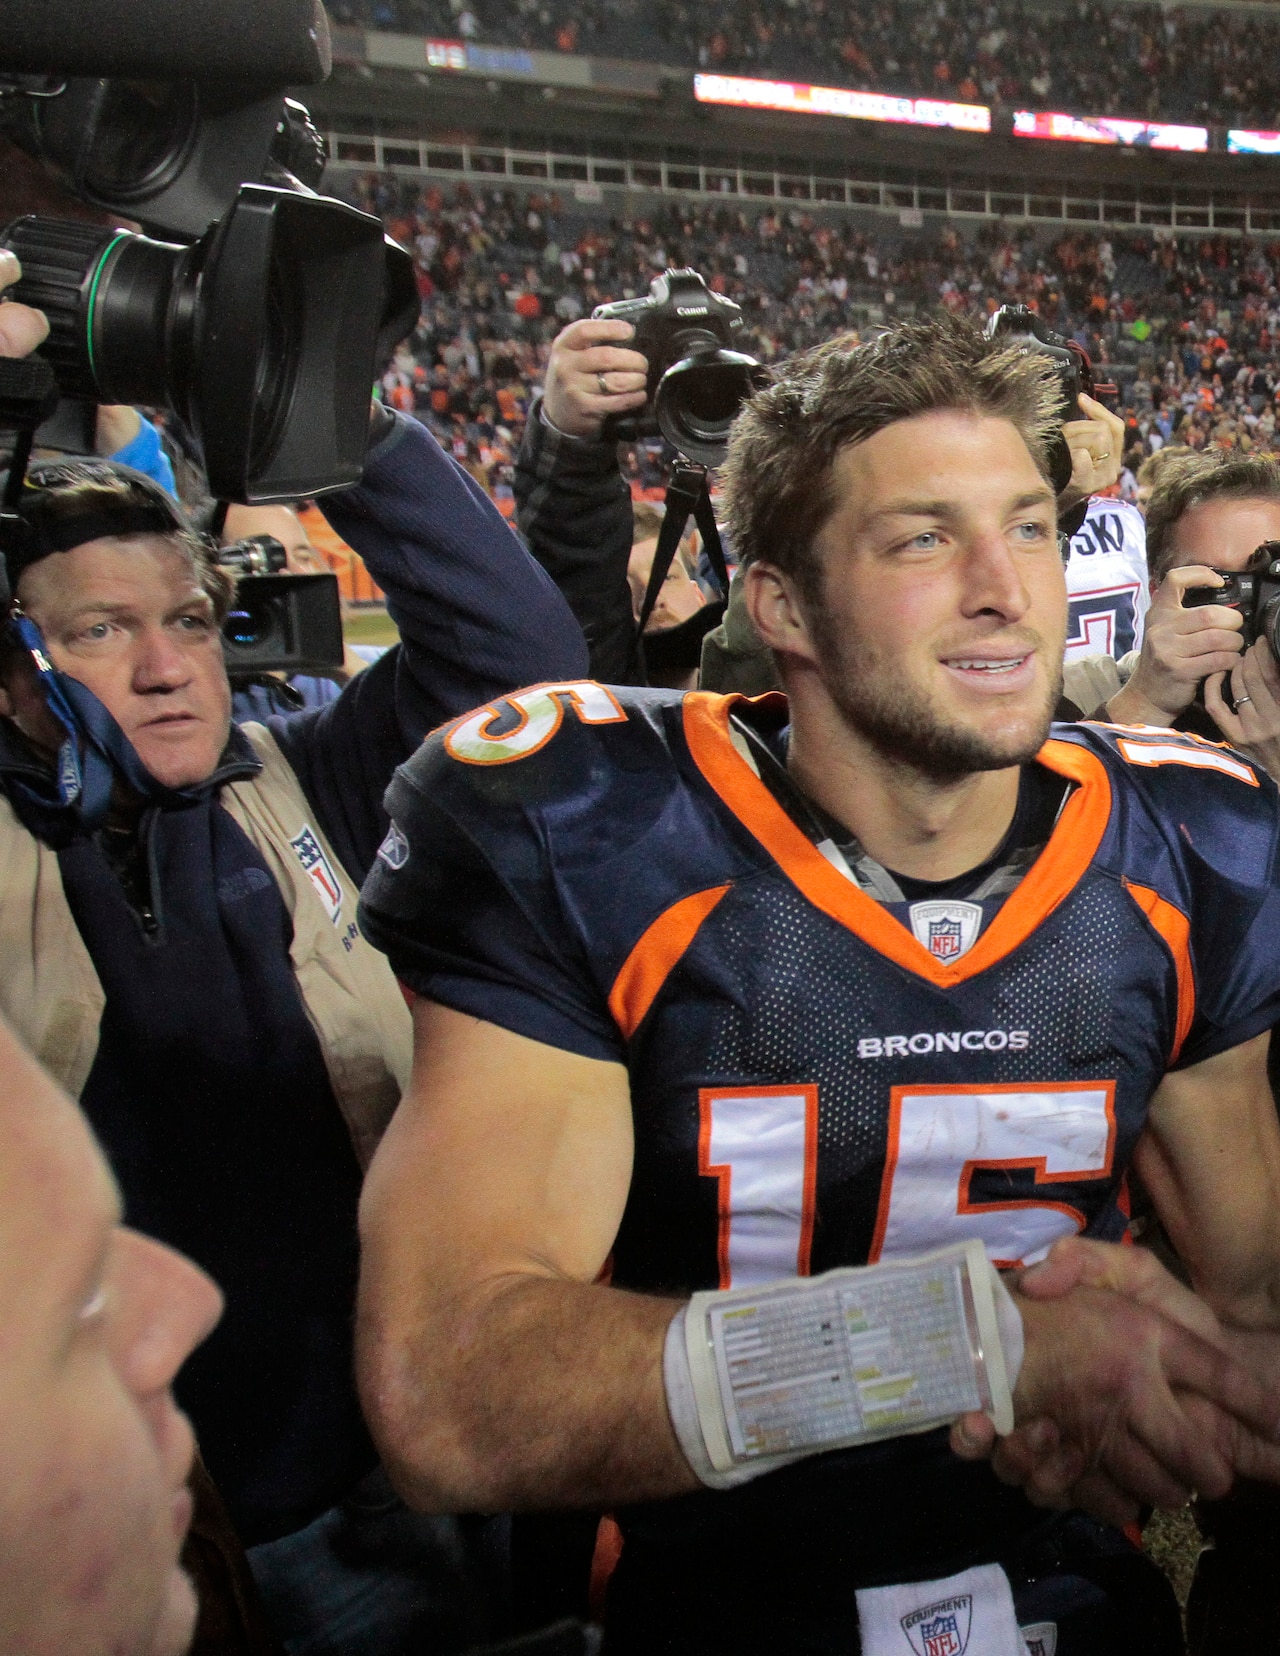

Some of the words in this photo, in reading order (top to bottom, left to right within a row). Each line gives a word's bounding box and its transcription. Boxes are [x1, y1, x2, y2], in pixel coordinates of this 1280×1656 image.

[677, 306, 708, 316] Canon
[931, 936, 959, 955] NFL
[857, 1030, 1030, 1059] BRONCOS
[699, 1080, 1117, 1290] 15
[905, 1599, 968, 1630] EQUIPMENT
[925, 1633, 958, 1656] NFL
